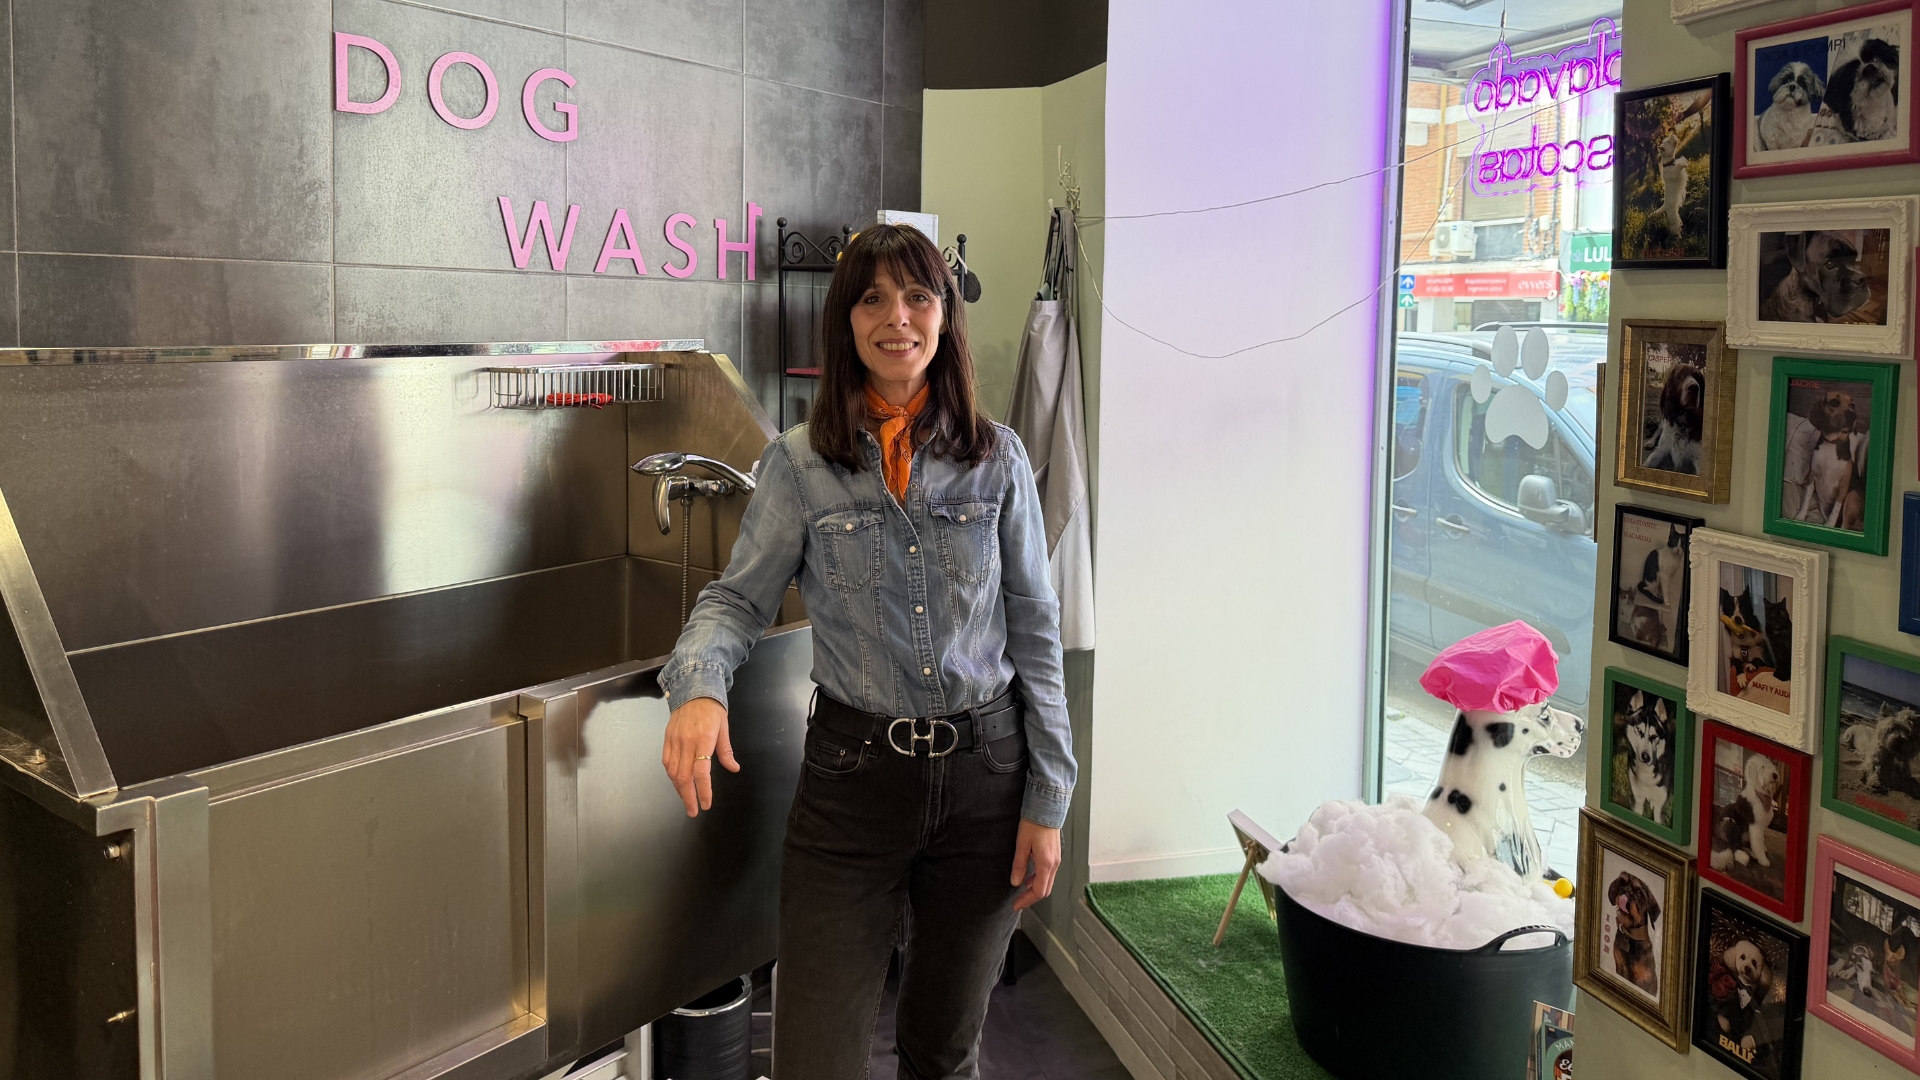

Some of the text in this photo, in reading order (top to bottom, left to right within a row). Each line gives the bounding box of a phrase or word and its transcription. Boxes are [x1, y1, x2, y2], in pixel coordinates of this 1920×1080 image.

[334, 32, 579, 142] DOG
[497, 196, 763, 281] WASH
[1583, 246, 1613, 263] LUL
[1790, 379, 1820, 389] JACKIE
